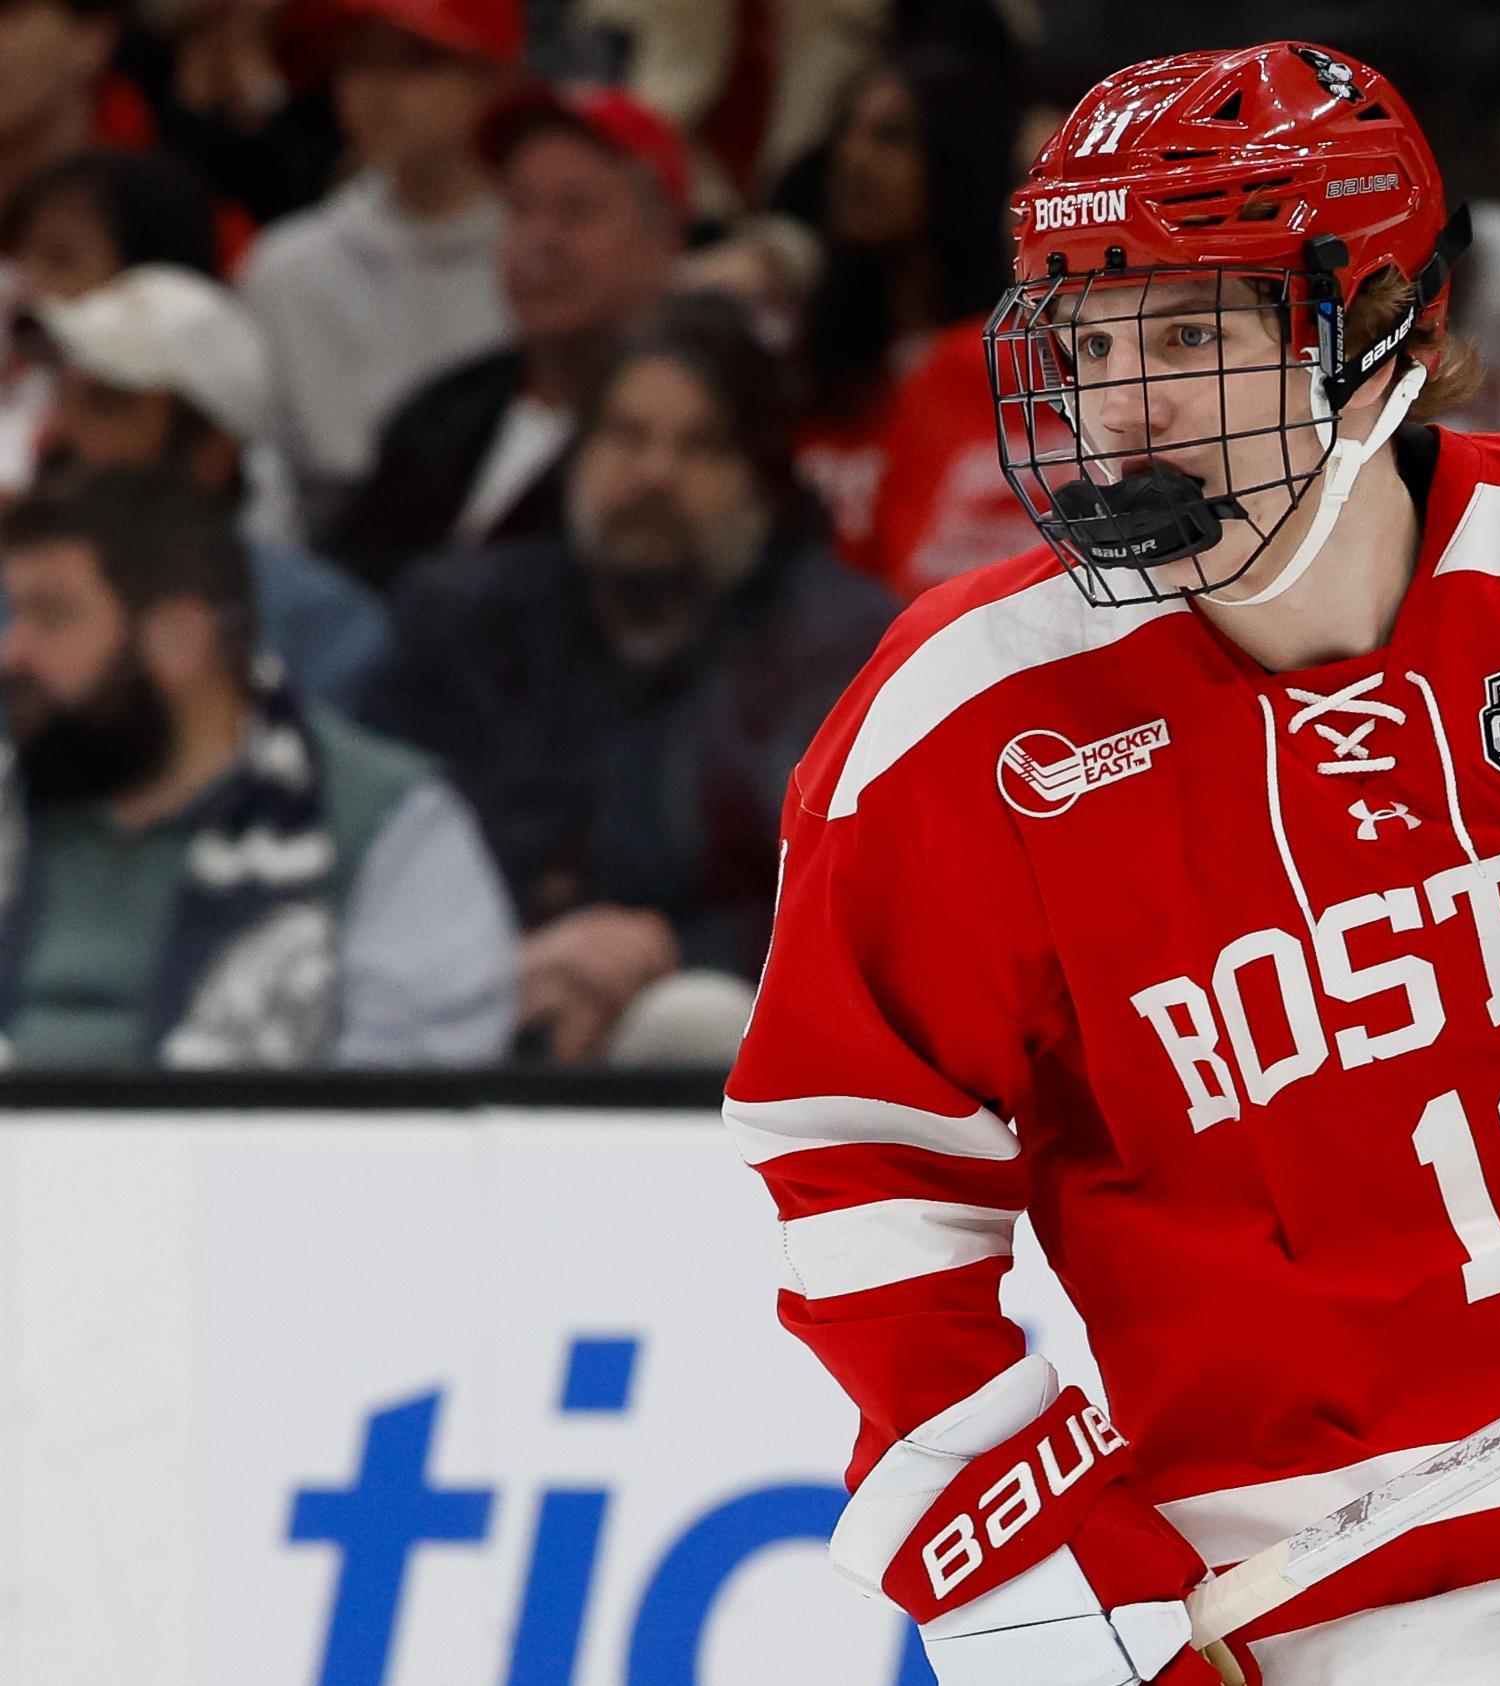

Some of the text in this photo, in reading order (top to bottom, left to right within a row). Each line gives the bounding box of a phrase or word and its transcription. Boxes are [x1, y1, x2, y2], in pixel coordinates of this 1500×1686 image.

[1074, 110, 1133, 158] 11
[1034, 187, 1129, 231] BOSTON
[1081, 724, 1162, 768] HOCKEY
[1084, 752, 1134, 785] EAST
[287, 1334, 943, 1686] tic
[921, 1405, 1131, 1600] BAUE
